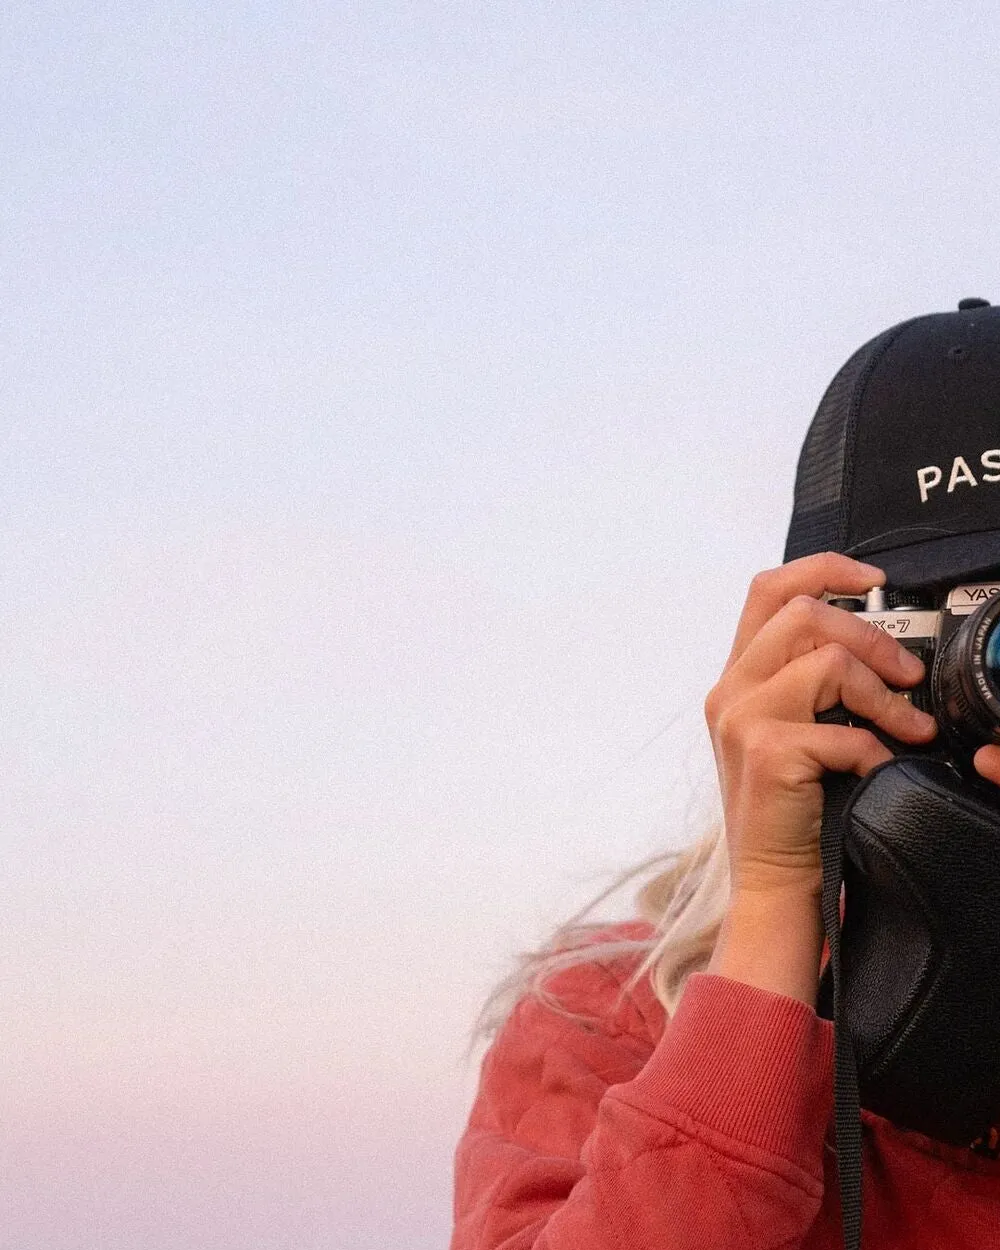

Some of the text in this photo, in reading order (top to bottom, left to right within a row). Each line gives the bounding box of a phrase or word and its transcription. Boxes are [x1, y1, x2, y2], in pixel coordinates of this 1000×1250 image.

[973, 616, 993, 700] MADE IN JAPAN
